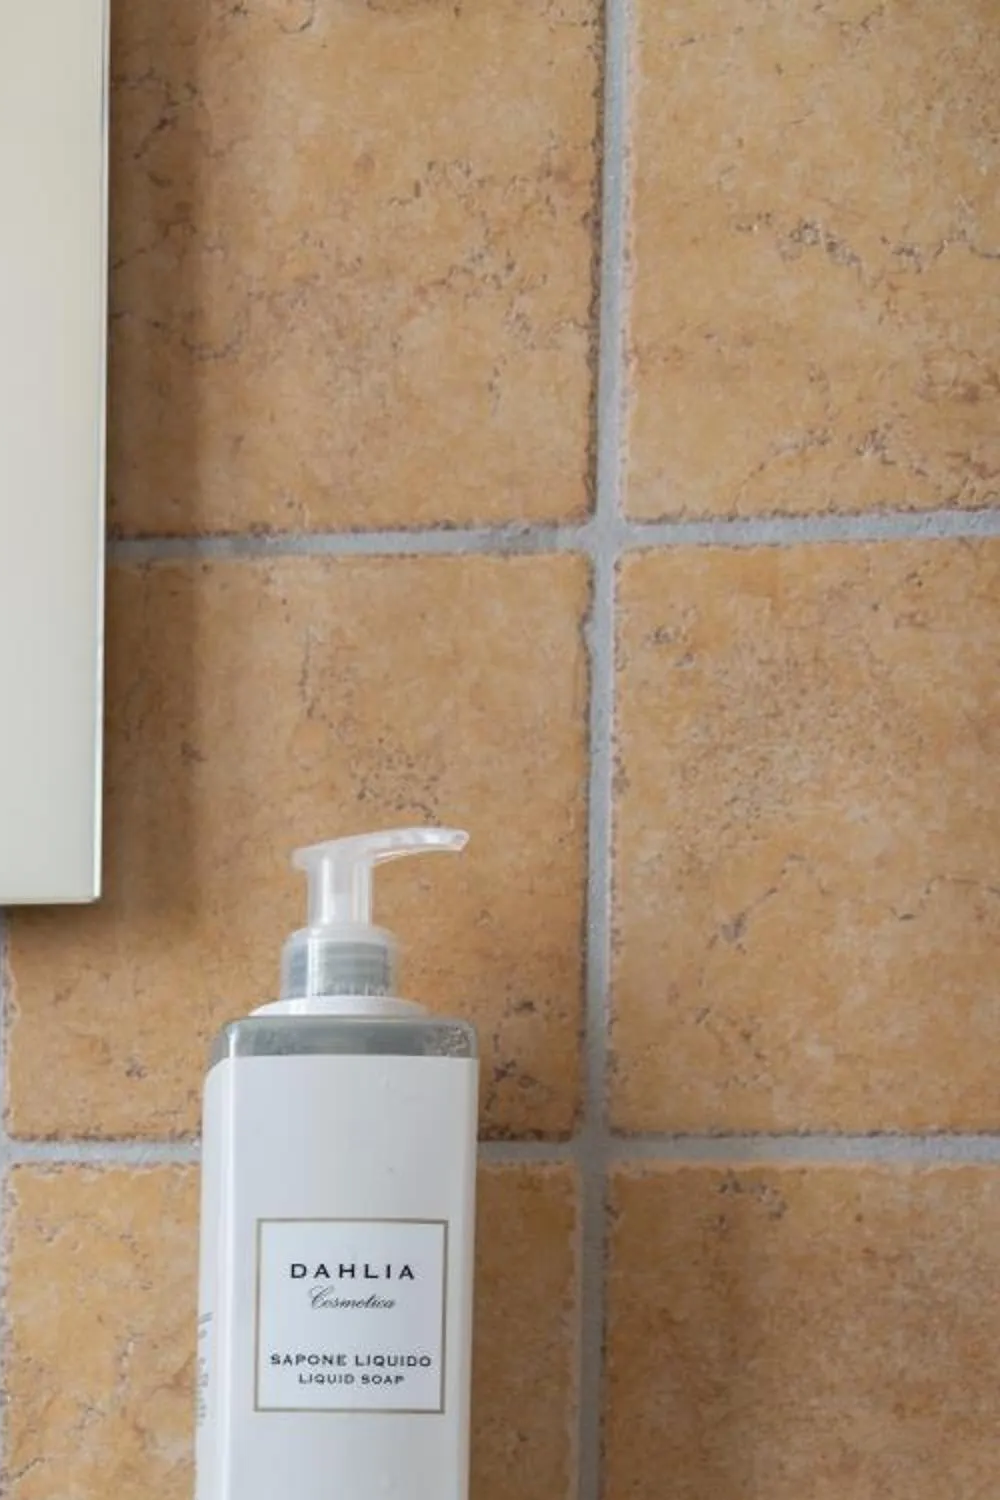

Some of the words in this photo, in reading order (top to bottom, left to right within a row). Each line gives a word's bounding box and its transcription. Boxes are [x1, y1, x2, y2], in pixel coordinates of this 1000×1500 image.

[290, 1263, 415, 1280] DAHLIA
[307, 1284, 397, 1310] Cosmetica
[269, 1353, 348, 1367] SAPONE
[354, 1354, 433, 1368] LIQUIDO
[298, 1372, 355, 1386] LIQUID
[360, 1373, 406, 1386] SOAP
